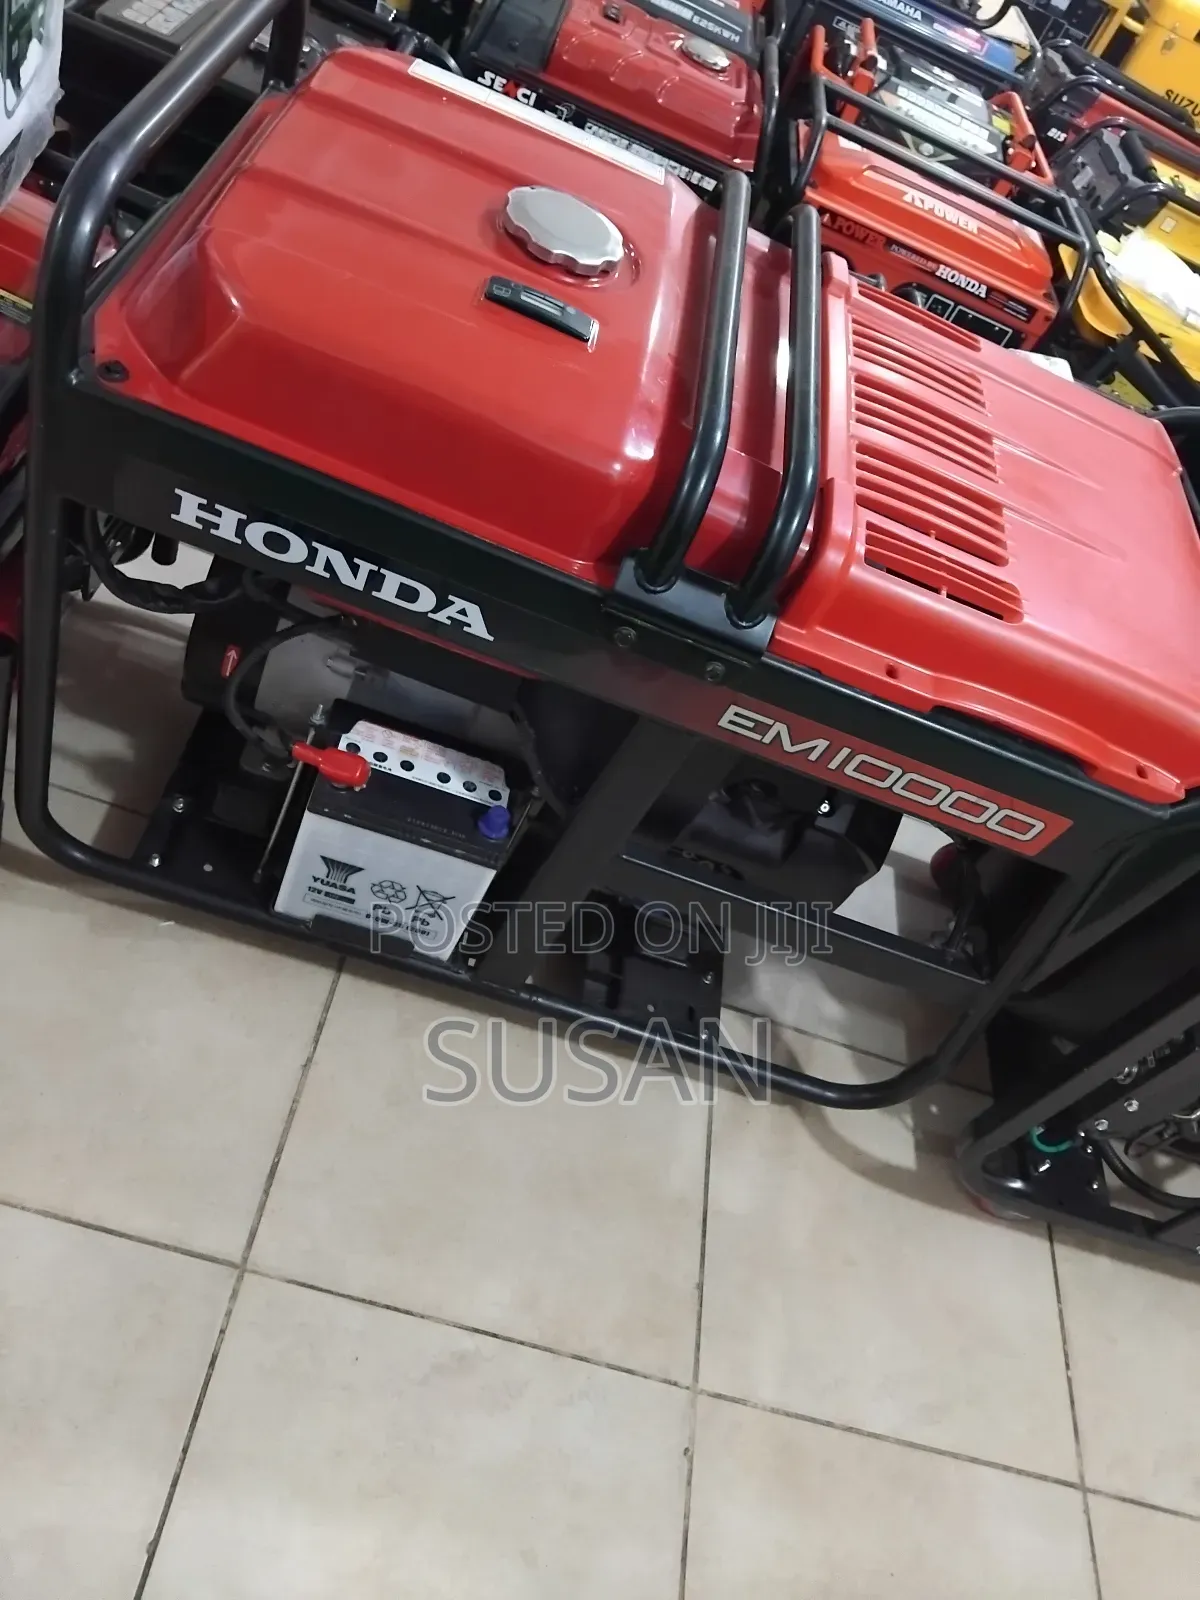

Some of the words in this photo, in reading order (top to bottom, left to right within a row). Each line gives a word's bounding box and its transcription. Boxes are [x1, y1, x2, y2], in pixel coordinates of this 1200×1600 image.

[878, 0, 922, 21] AMAHA
[935, 264, 988, 299] HONDA
[171, 488, 495, 641] HONDA
[717, 704, 1046, 842] EM10000
[312, 875, 356, 894] YUASA
